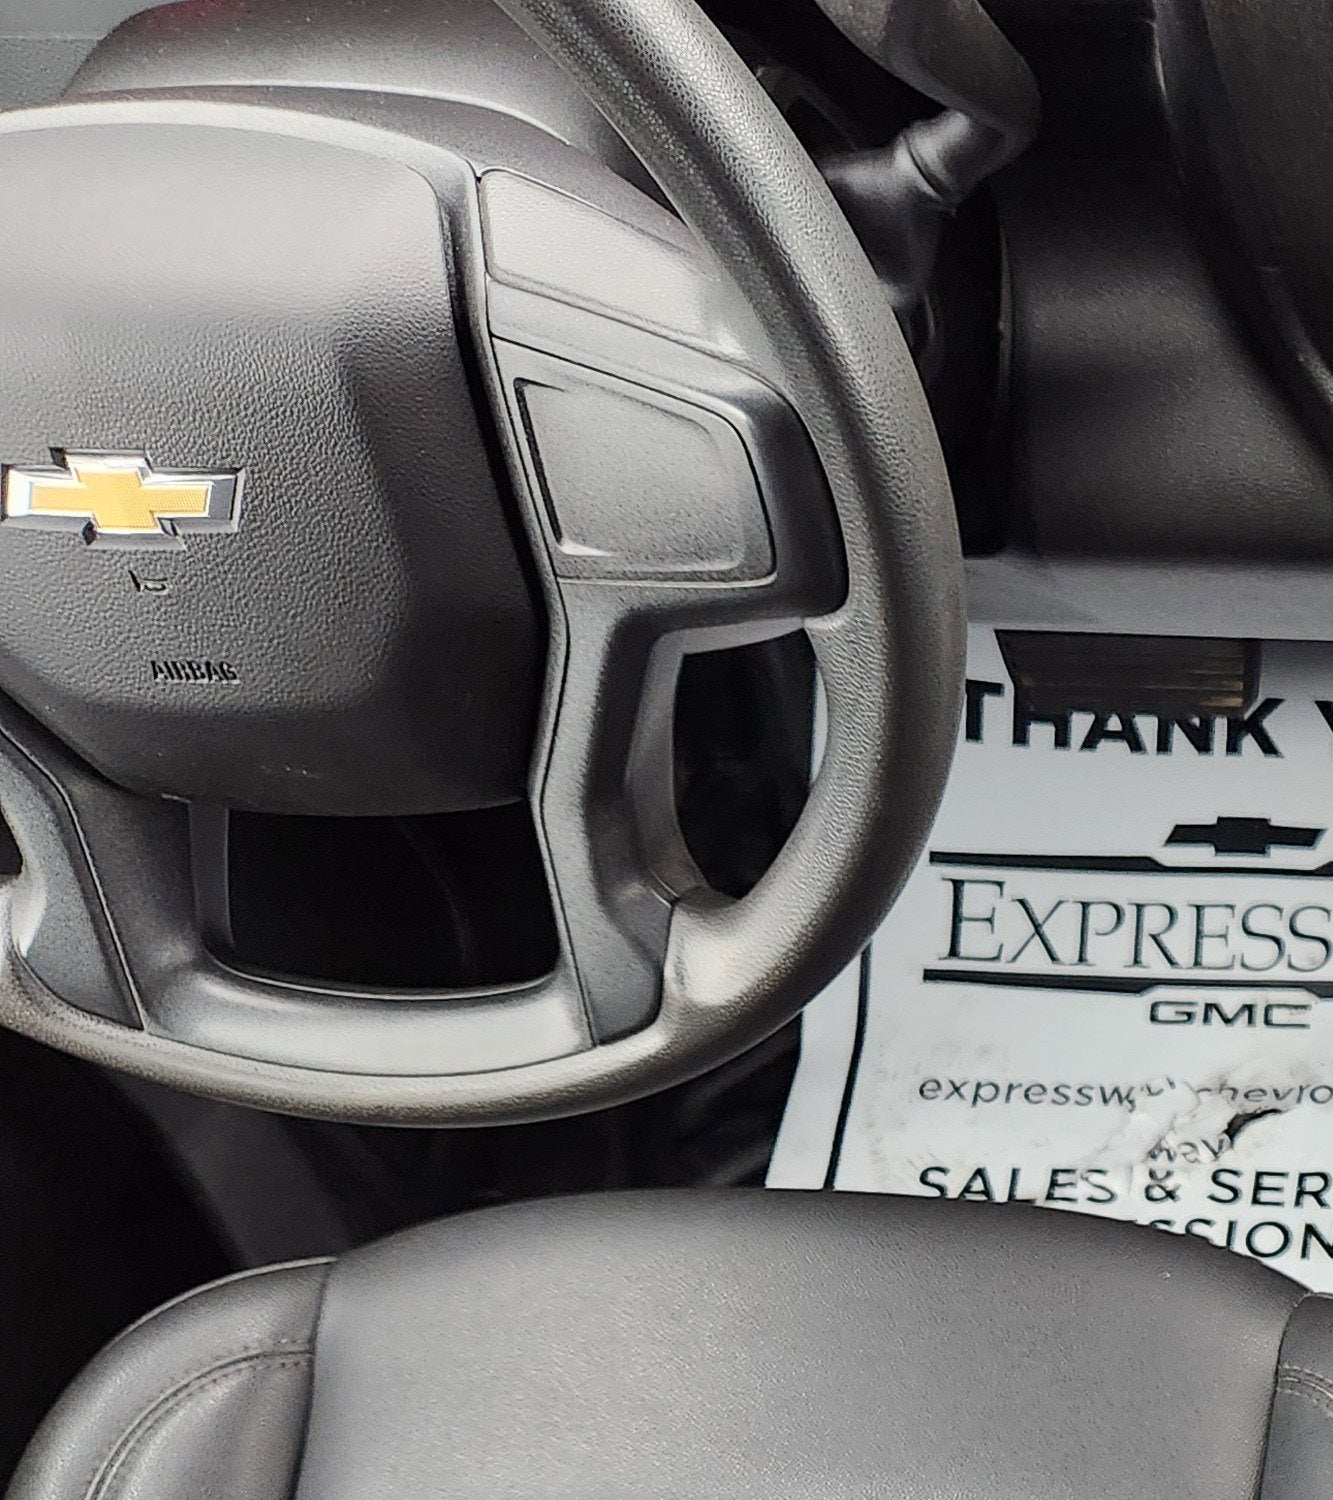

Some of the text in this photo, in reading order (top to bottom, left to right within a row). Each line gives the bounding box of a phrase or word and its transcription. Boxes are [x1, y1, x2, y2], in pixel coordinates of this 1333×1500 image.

[150, 659, 240, 684] AIRBAG
[1149, 1000, 1311, 1030] GMC
[919, 1166, 1118, 1204] SALES
